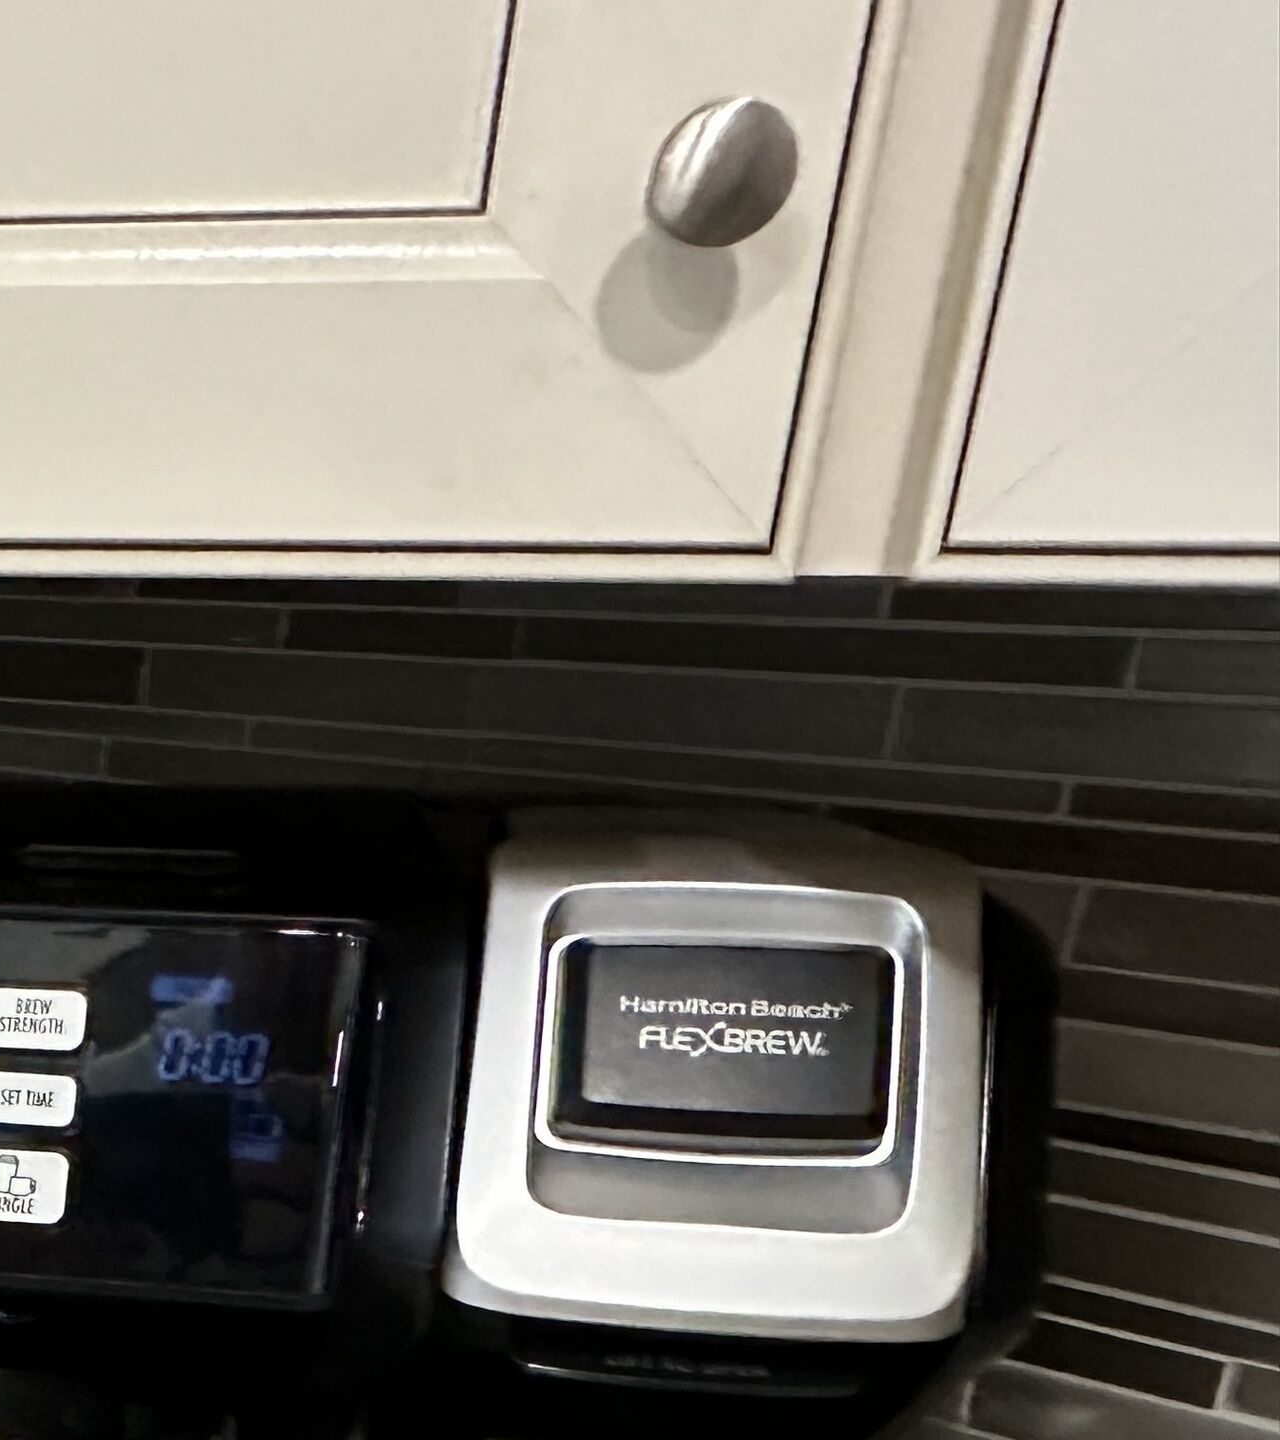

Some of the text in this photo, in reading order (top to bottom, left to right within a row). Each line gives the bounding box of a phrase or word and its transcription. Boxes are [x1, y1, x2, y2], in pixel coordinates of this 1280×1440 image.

[15, 997, 53, 1016] BREW
[619, 994, 747, 1016] Hamilton
[0, 1016, 64, 1035] STRENGTH
[0, 1088, 22, 1107] SET
